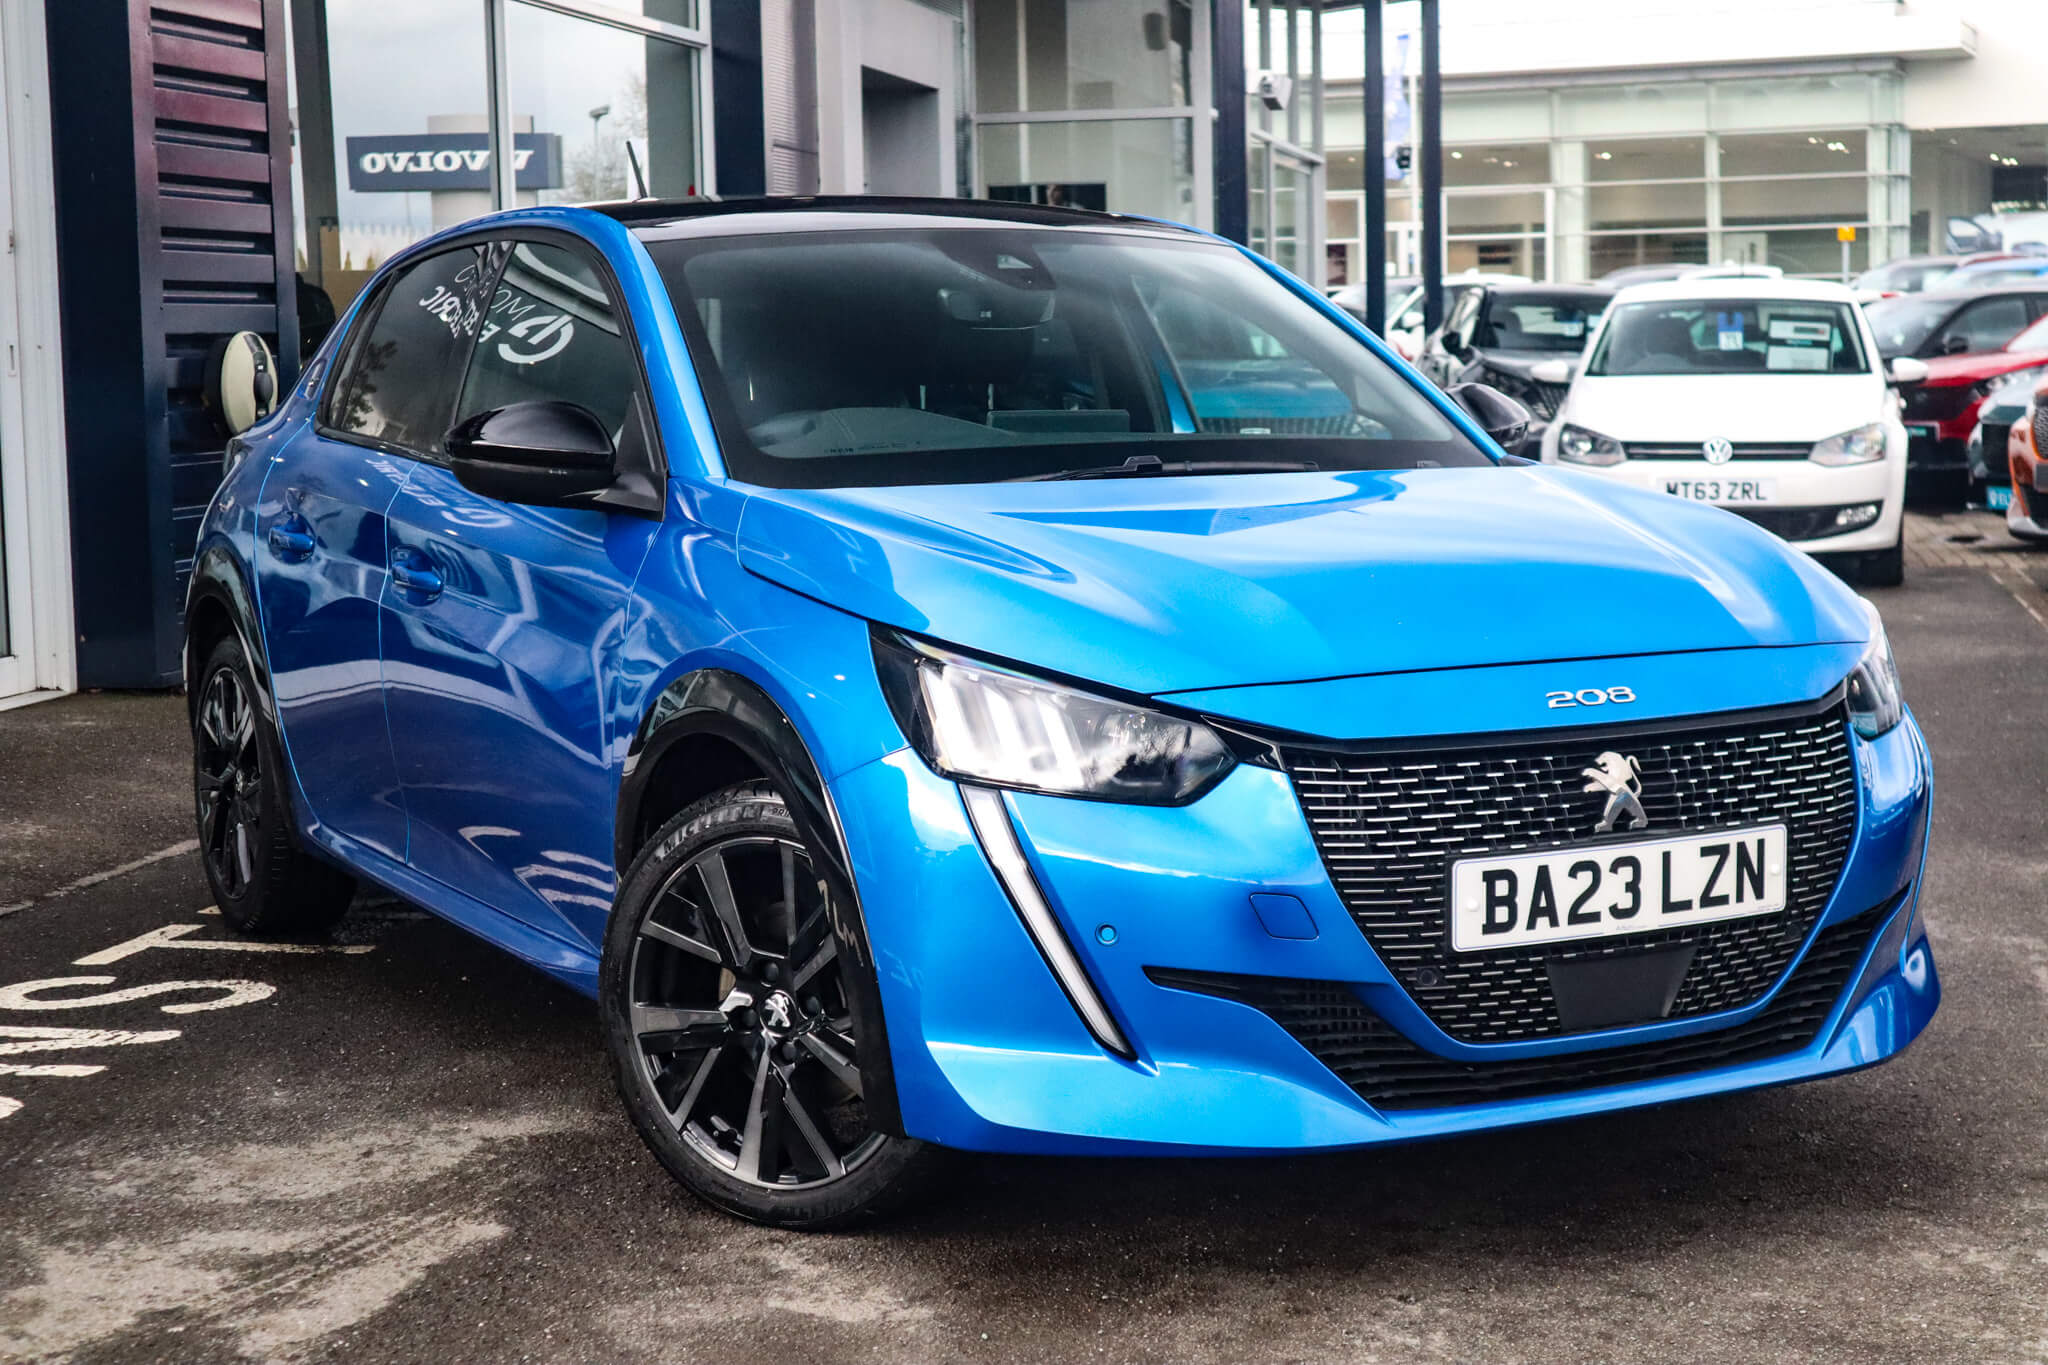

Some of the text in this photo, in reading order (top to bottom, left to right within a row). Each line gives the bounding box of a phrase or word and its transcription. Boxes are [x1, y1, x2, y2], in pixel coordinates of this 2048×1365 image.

[1665, 481, 1767, 500] MT63 ZRL
[1545, 686, 1637, 709] 208
[1482, 837, 1766, 936] BA23 LZN
